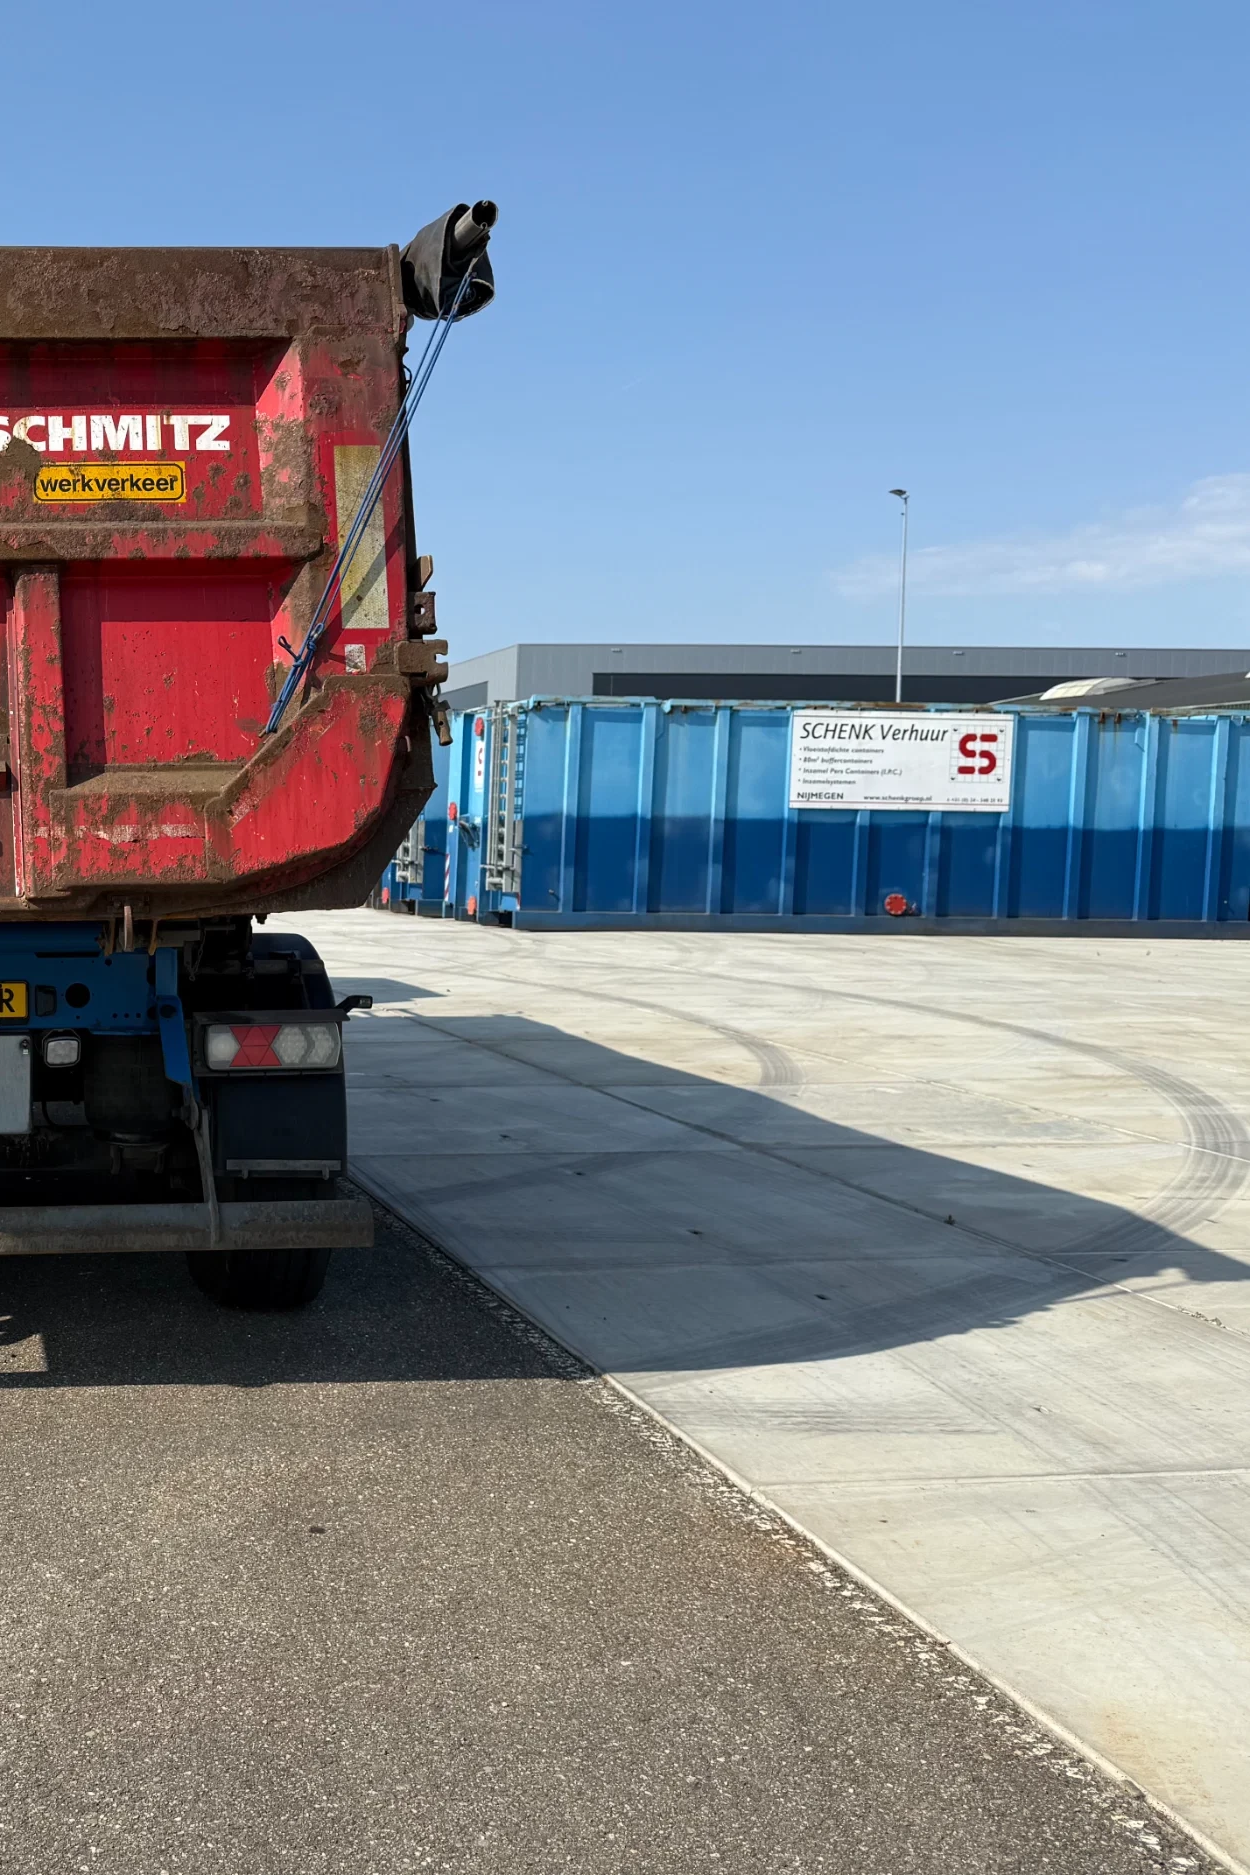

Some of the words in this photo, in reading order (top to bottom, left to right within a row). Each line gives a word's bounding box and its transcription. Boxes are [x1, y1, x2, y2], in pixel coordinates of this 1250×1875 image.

[39, 474, 177, 493] werkverkeer
[800, 722, 877, 741] SCHENK
[880, 723, 949, 742] Verhuur
[797, 792, 844, 801] NIJMEGEN
